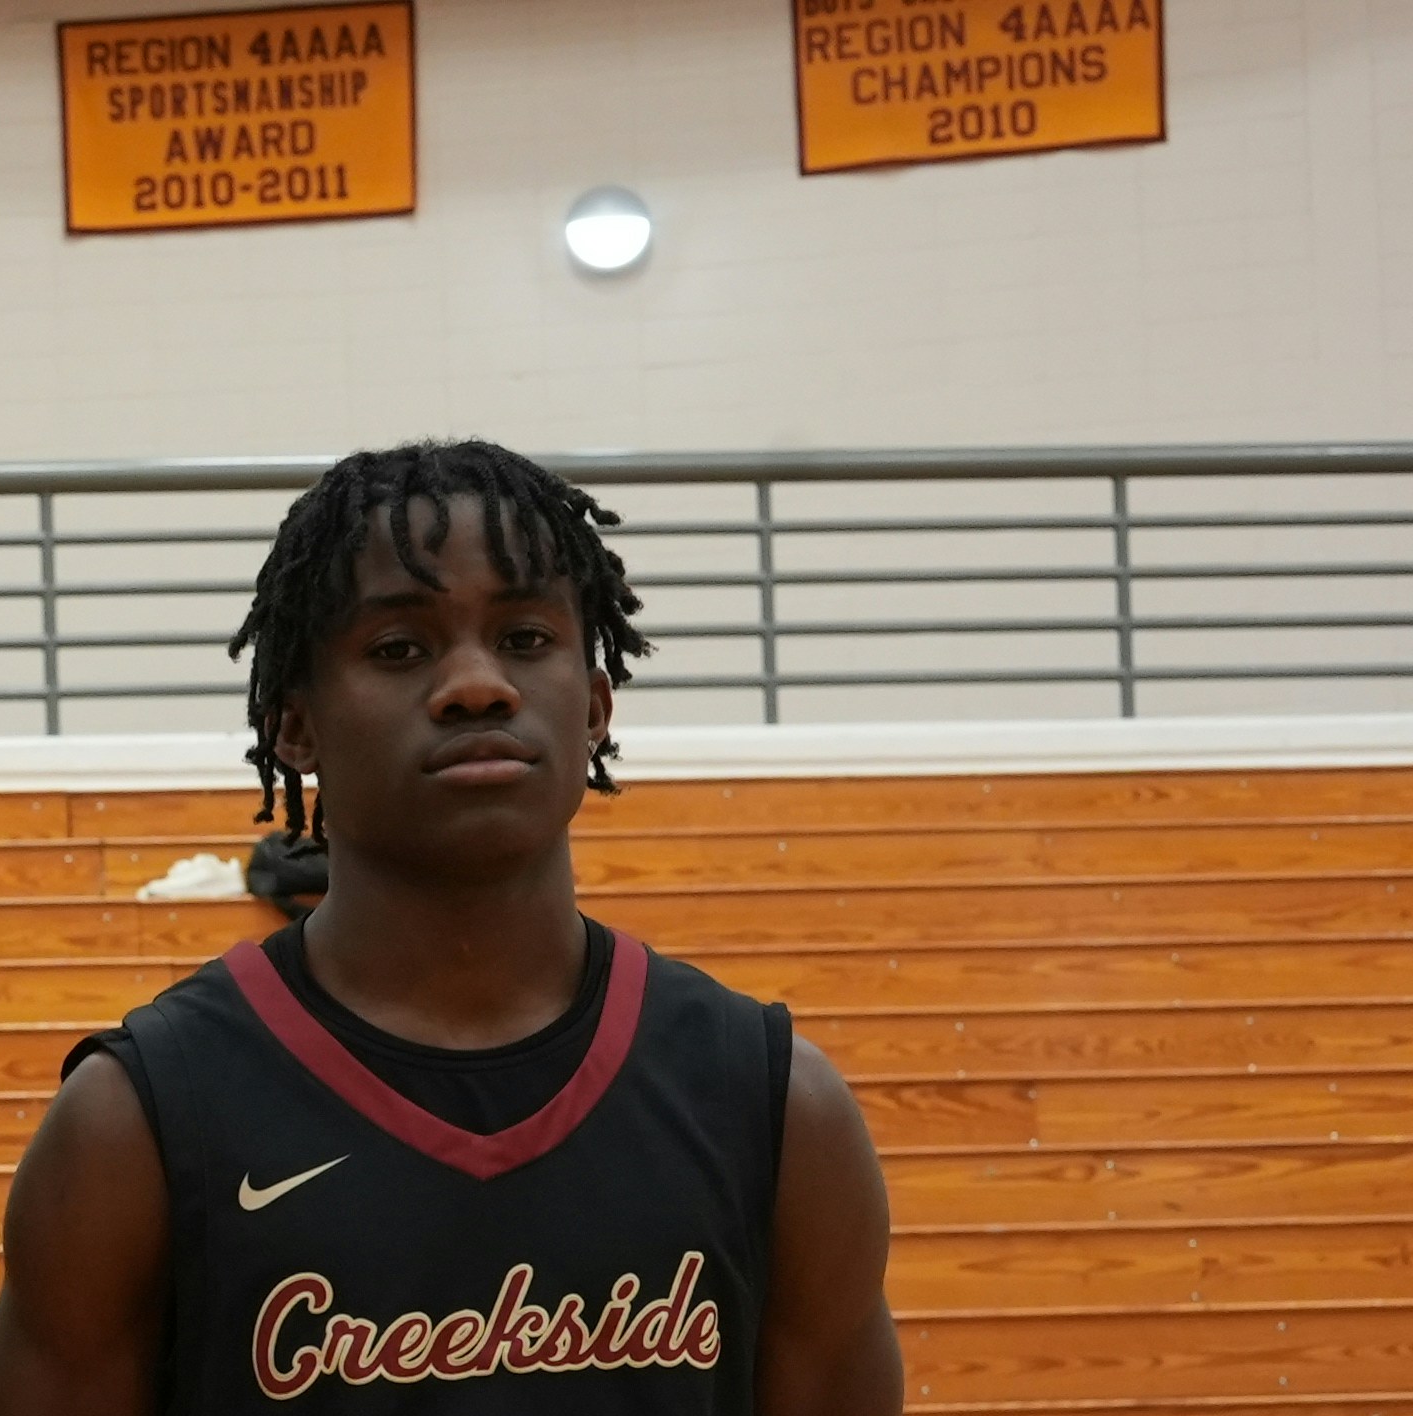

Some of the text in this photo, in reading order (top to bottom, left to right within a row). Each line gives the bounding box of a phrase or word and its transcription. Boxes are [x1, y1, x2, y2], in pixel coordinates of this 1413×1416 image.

[86, 22, 386, 77] REGION 4AAAA
[805, 1, 1151, 63] REGION 4AAAA
[107, 70, 369, 123] SPORTSMANSHIP
[850, 45, 1108, 106] CHAMPIONS
[164, 119, 317, 165] AWARD
[927, 100, 1038, 146] 2010
[134, 165, 349, 212] 2010-2011
[252, 1251, 721, 1400] Creekside
